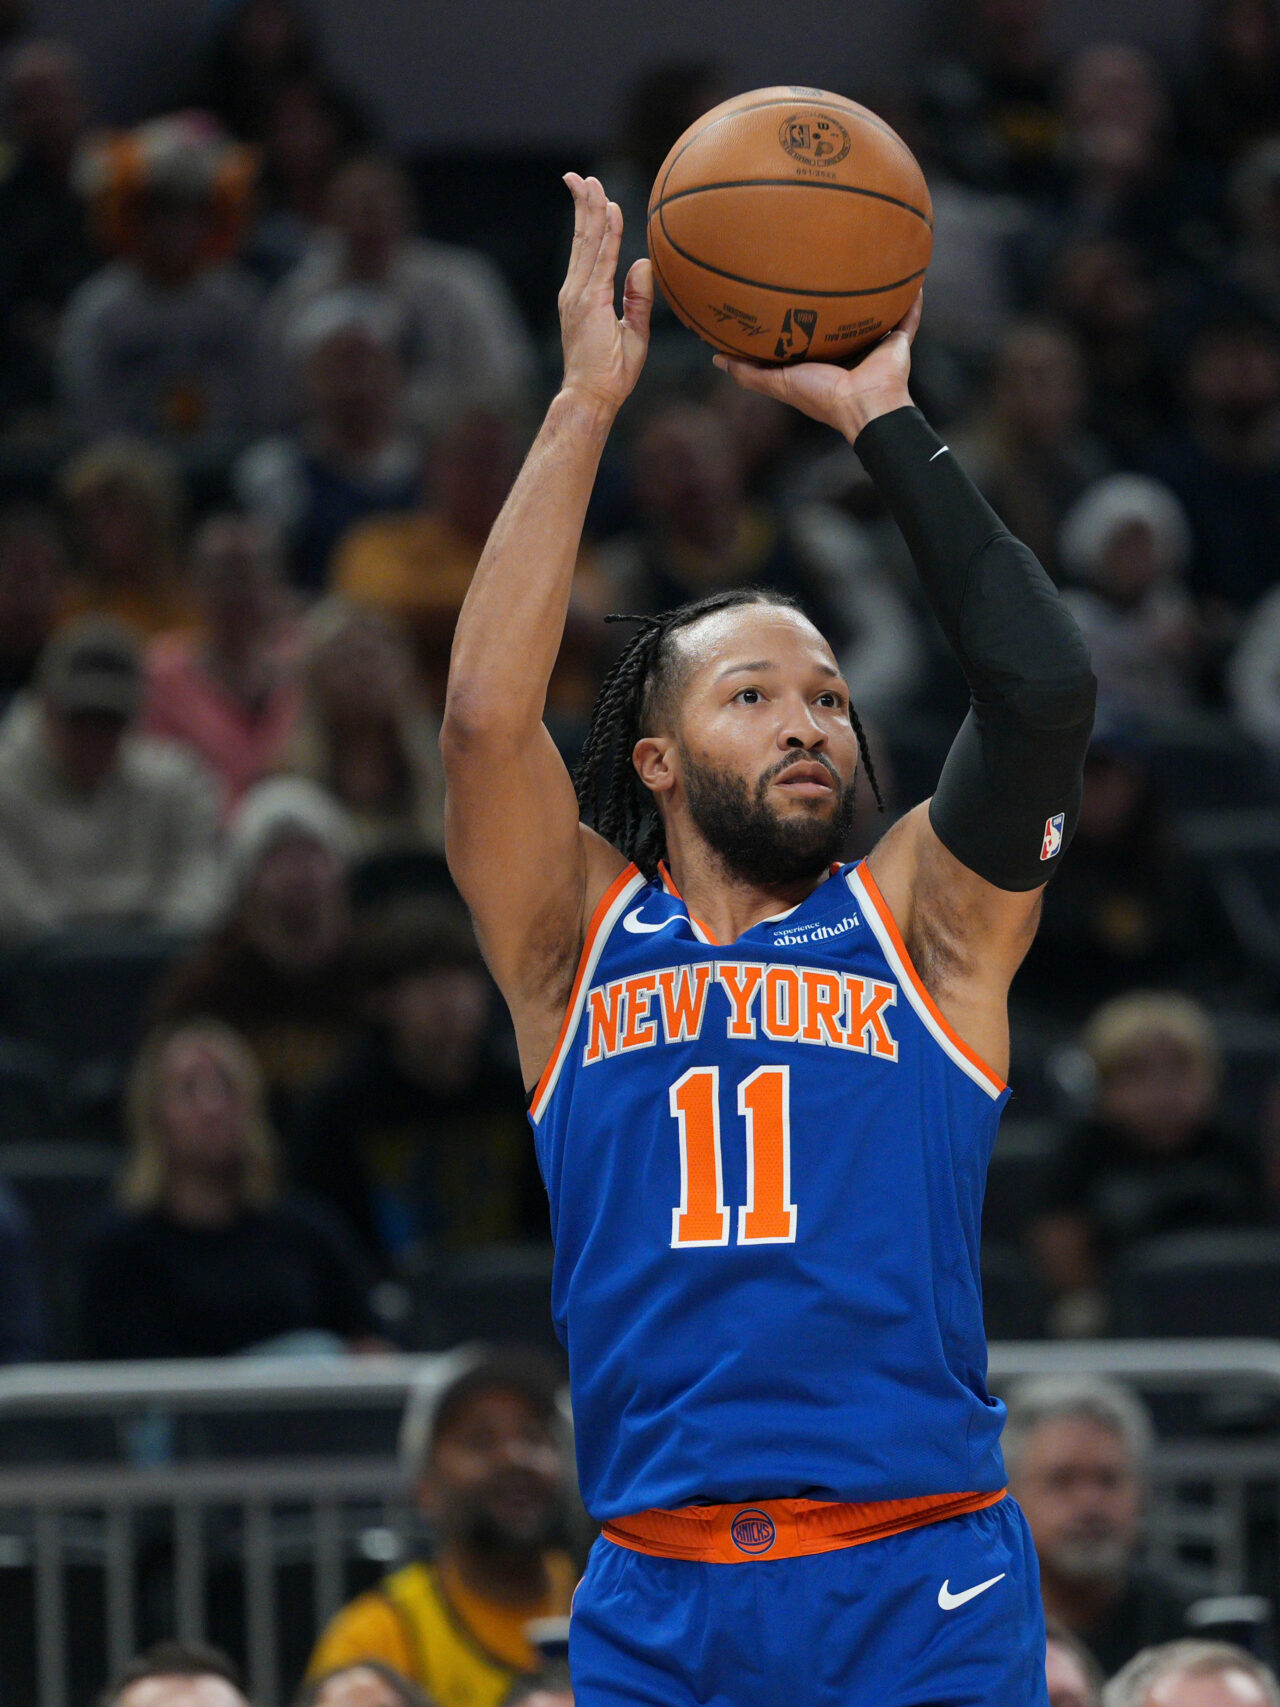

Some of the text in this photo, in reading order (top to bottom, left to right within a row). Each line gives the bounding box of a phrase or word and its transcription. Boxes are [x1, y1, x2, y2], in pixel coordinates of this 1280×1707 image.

[797, 311, 815, 324] NBA
[773, 922, 820, 936] experience
[773, 934, 809, 947] abu
[582, 961, 899, 1067] NEW YORK
[668, 1064, 798, 1249] 11
[735, 1521, 770, 1543] KNICKS
